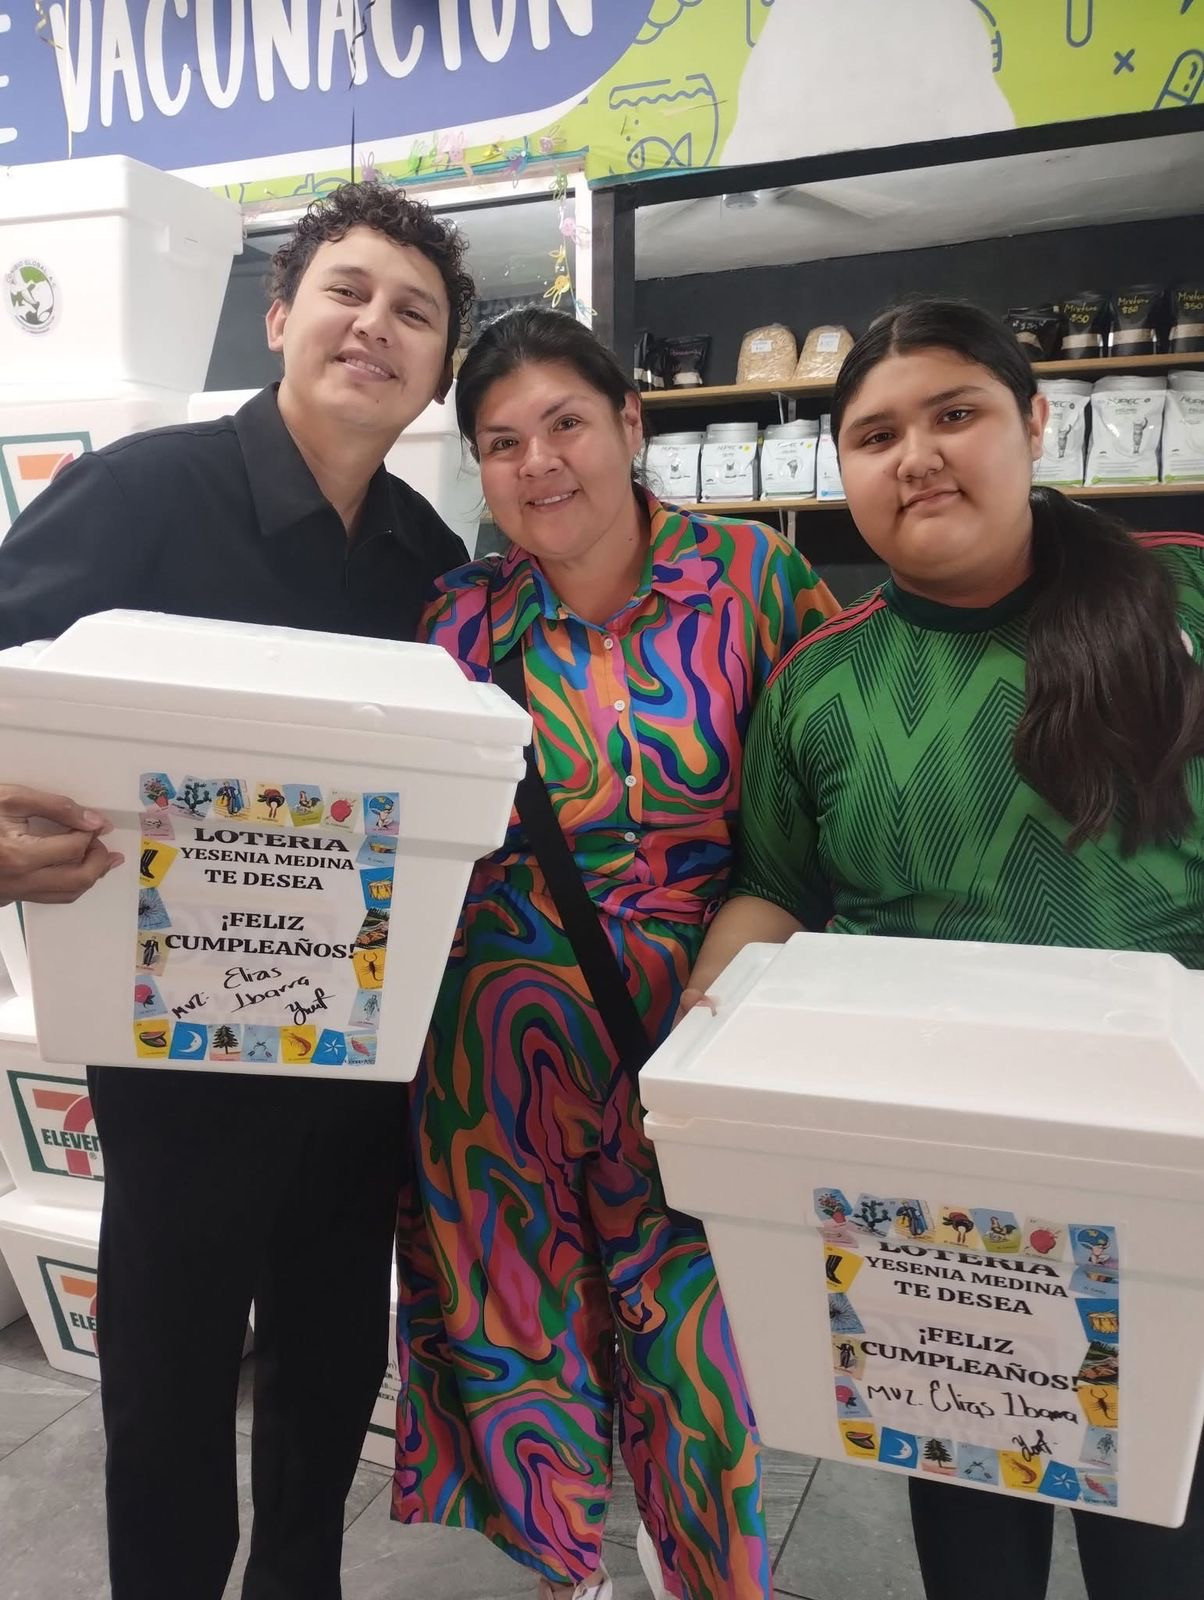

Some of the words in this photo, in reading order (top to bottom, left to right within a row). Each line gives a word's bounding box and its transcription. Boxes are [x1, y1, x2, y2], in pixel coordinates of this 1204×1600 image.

[194, 827, 350, 853] LOTERIA
[180, 847, 270, 865] YESENIA
[275, 854, 355, 871] MEDINA
[204, 869, 237, 885] TE
[243, 871, 324, 890] DESEA
[222, 912, 305, 932] ¡FELIZ
[165, 934, 355, 959] CUMPLEAÑOS!
[223, 966, 282, 990] Elias
[878, 1240, 1060, 1279] LOTERIA
[865, 1255, 966, 1283] YESENIA
[972, 1271, 1069, 1299] MEDINA
[894, 1280, 931, 1300] TE
[937, 1286, 1033, 1316] DESEA
[919, 1326, 1014, 1356] ¡FELIZ
[860, 1341, 1079, 1393] CUMPLEAÑOS!
[930, 1380, 995, 1419] Elias
